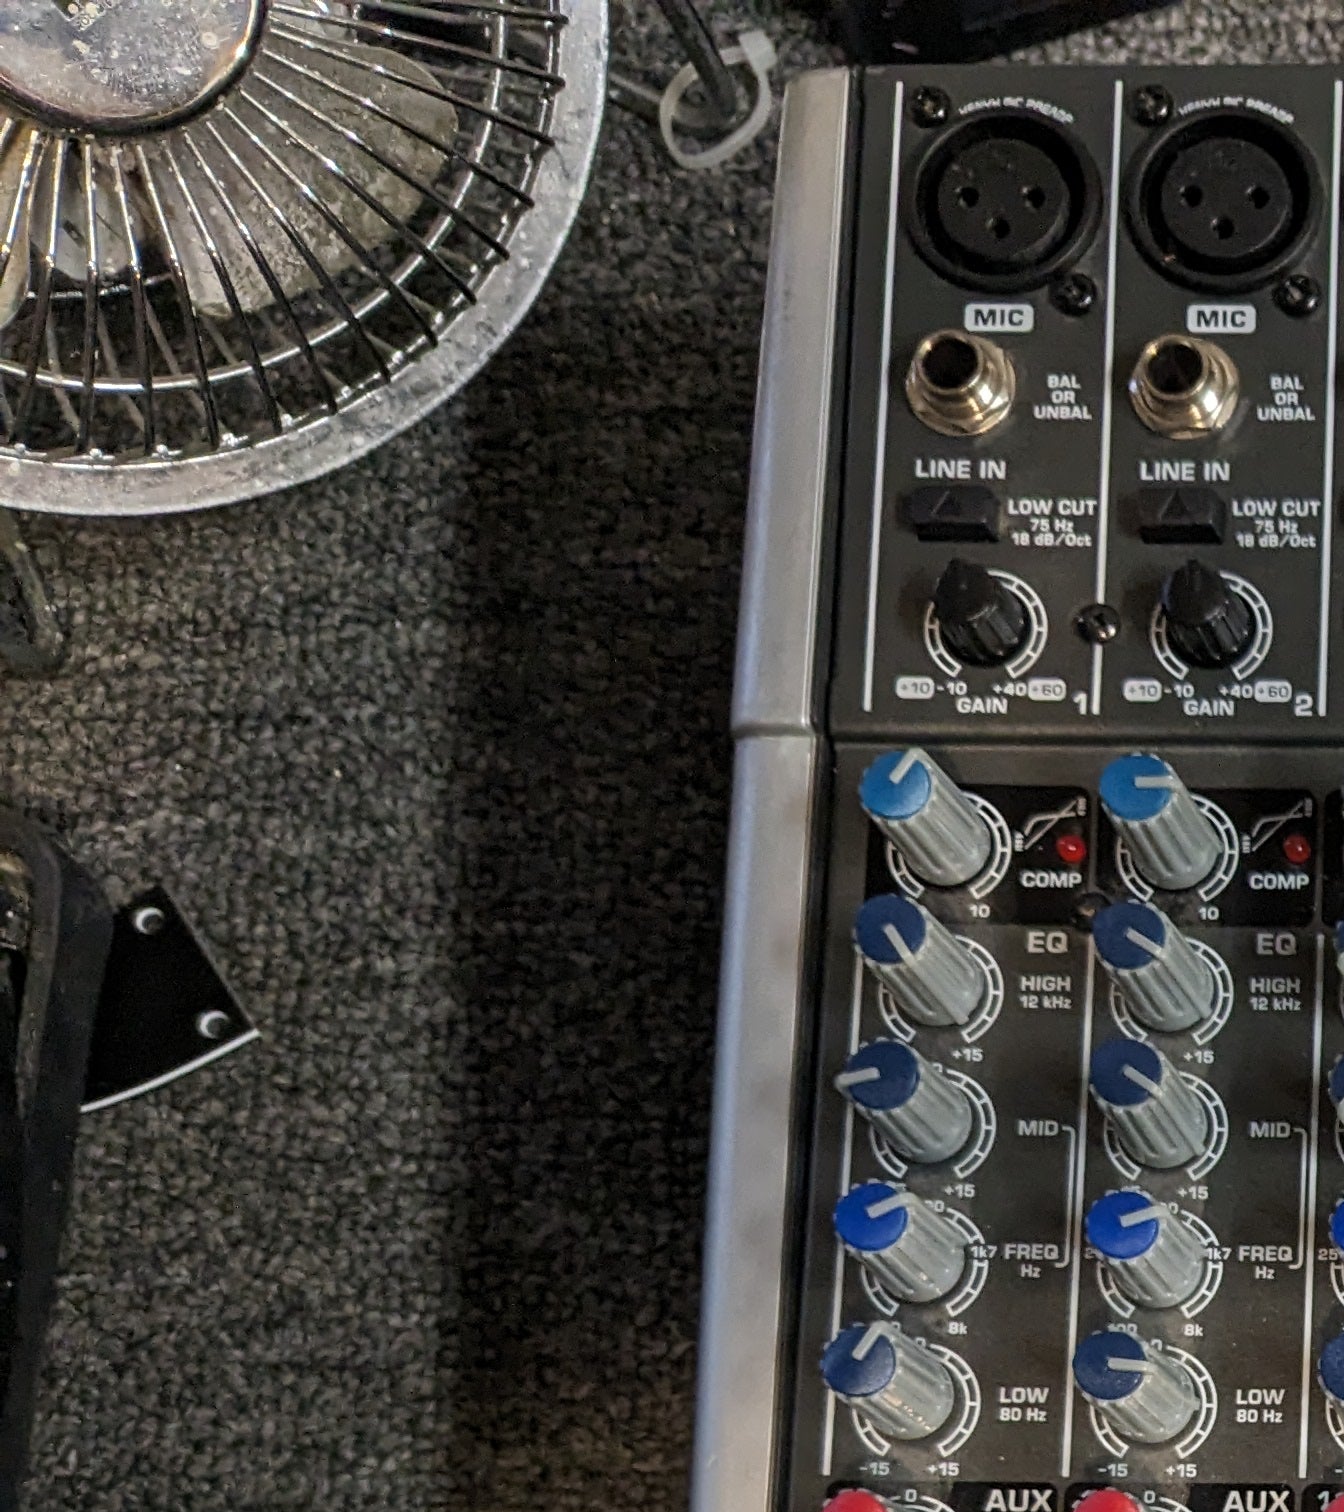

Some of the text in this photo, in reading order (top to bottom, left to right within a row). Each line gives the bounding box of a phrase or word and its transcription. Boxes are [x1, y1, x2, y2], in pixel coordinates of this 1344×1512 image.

[974, 308, 1024, 327] MIC
[915, 459, 1006, 480] LINE IN
[1020, 871, 1082, 888] COMP
